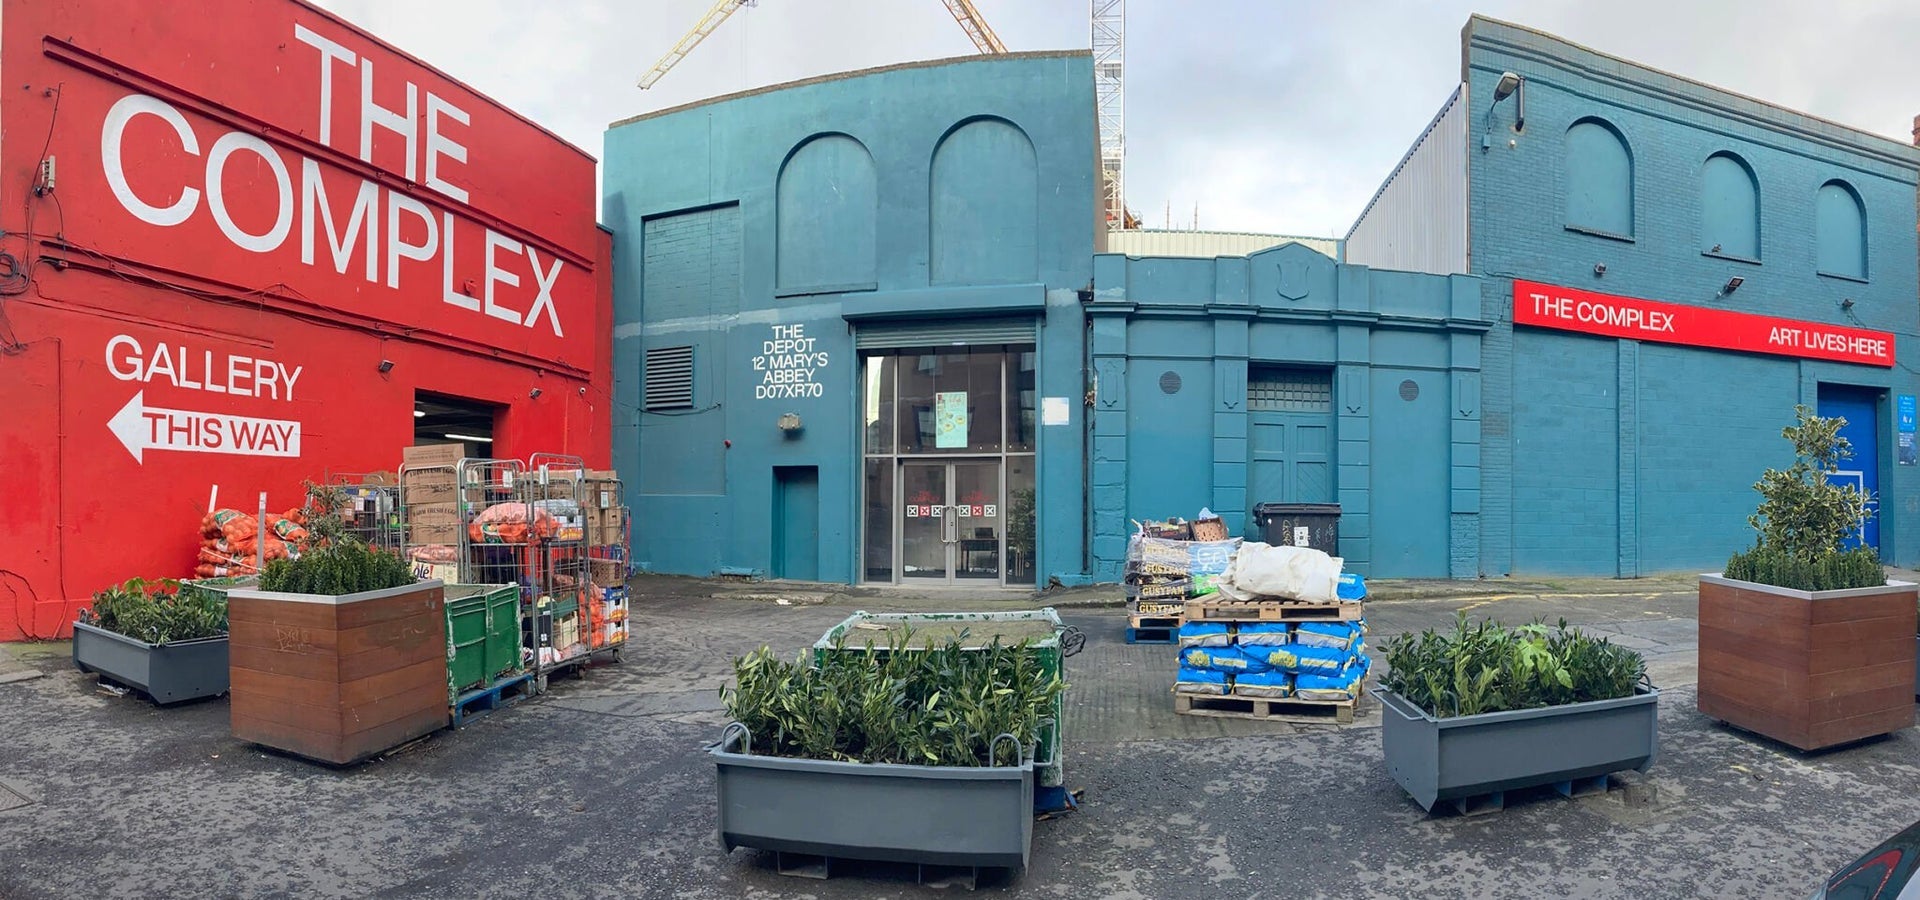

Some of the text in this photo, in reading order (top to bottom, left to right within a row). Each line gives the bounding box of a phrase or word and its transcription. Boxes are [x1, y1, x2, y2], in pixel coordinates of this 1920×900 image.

[294, 22, 471, 205] THE
[100, 93, 564, 339] COMPLEX
[1530, 293, 1675, 333] THE COMPLEX
[763, 338, 816, 355] DEPOT
[772, 324, 804, 339] THE
[1769, 326, 1887, 358] ART LIVES HERE
[105, 334, 303, 402] GALLERY
[752, 352, 829, 370] 12 MARY'S
[763, 368, 815, 384] ABBEY
[756, 383, 823, 399] D07XR70
[142, 412, 295, 452] THIS WAY
